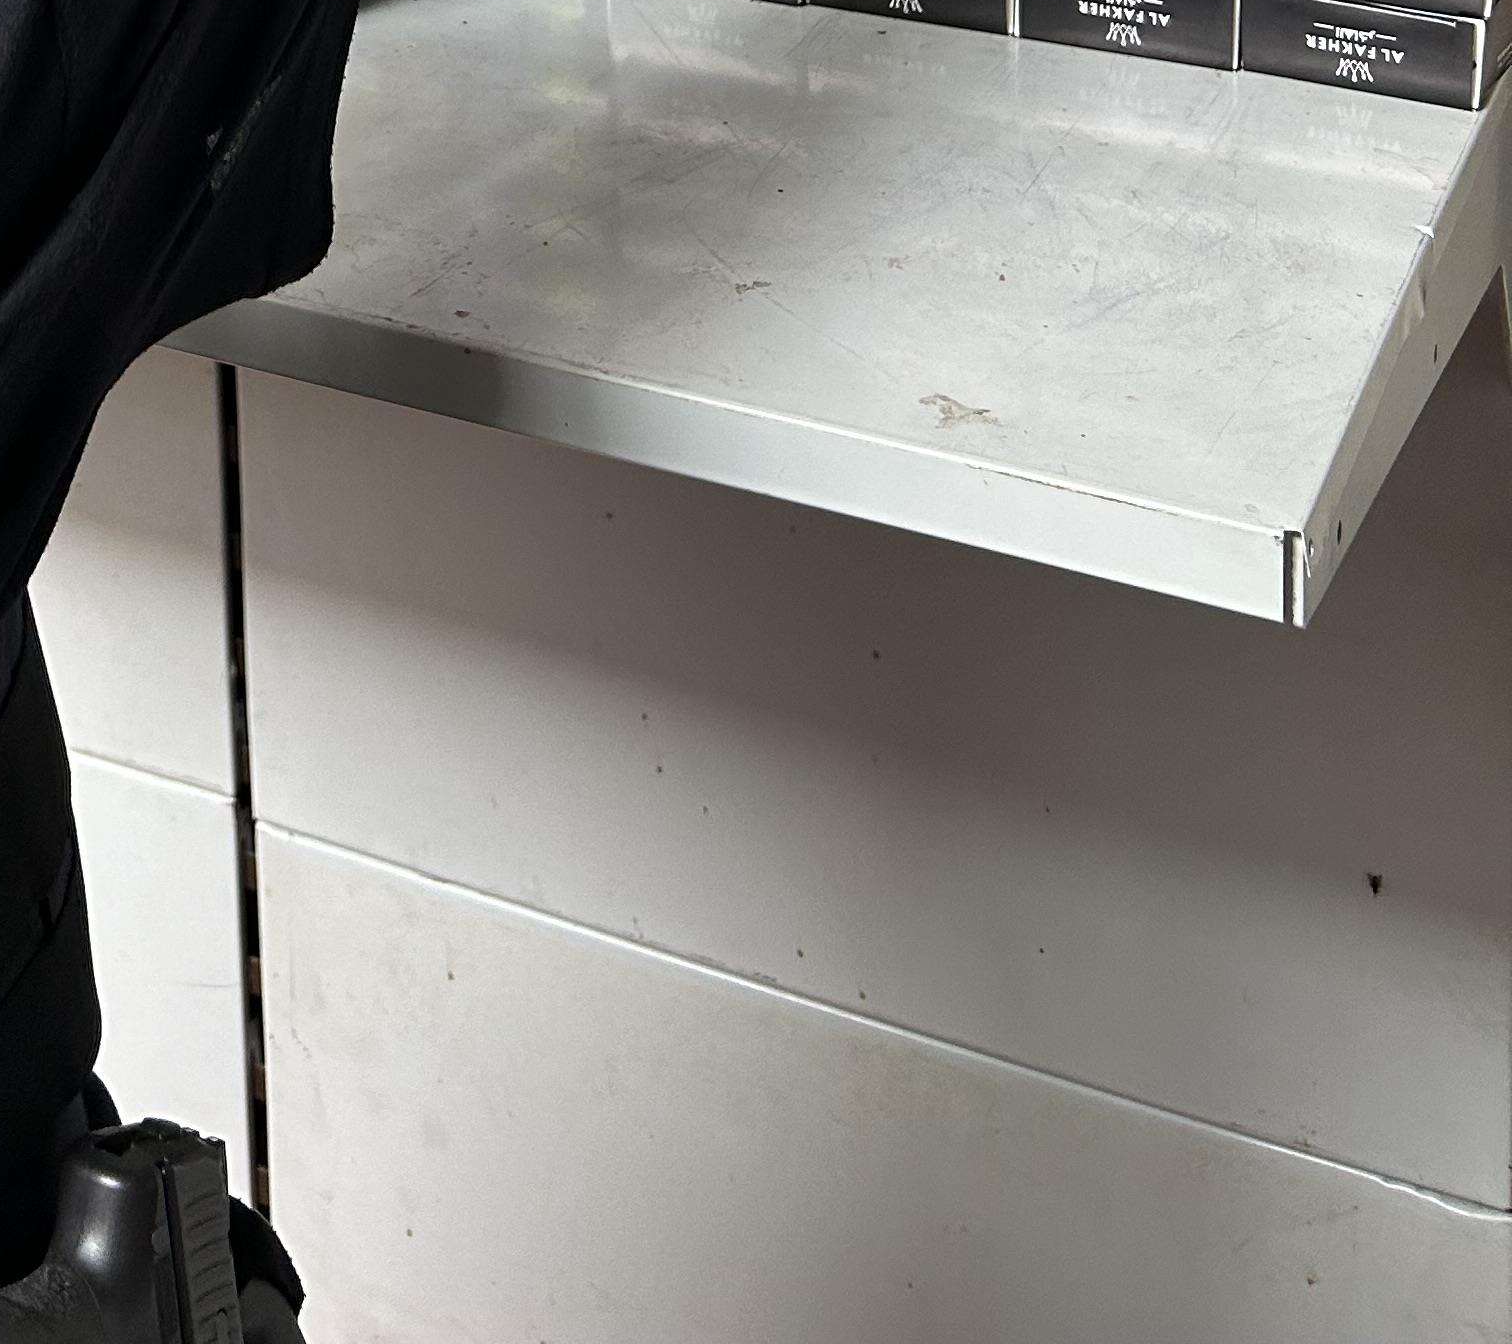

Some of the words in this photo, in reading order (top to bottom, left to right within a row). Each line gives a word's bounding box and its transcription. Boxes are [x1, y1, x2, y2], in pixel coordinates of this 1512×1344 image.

[1077, 1, 1144, 22] FAKHER
[1148, 11, 1170, 24] AL
[1305, 34, 1376, 58] FAKHER
[1380, 48, 1404, 61] AL
